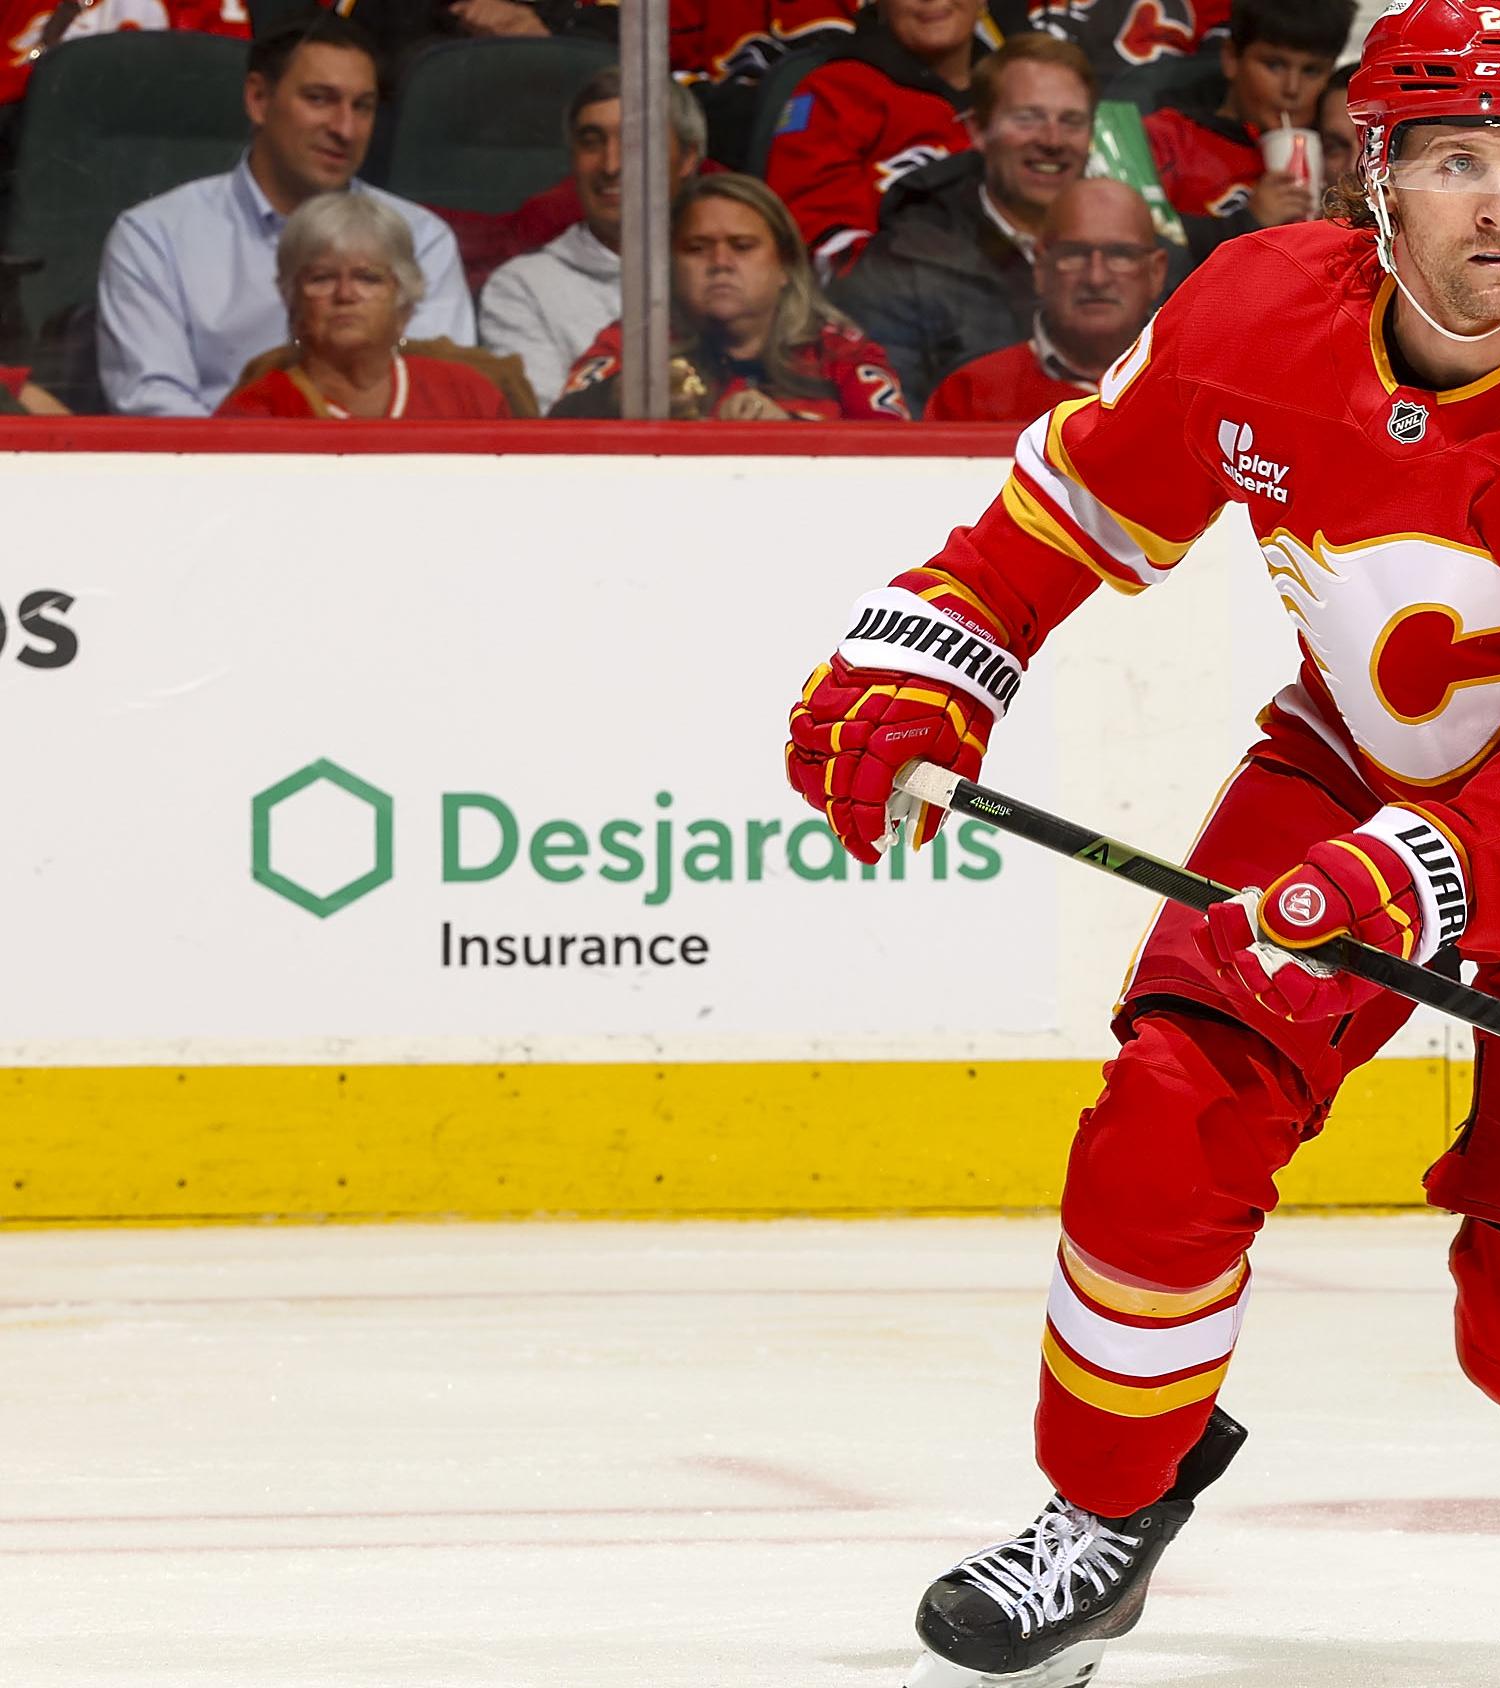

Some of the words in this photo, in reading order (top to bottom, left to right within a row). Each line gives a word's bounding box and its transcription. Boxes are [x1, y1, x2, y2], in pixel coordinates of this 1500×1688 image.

[1395, 414, 1421, 432] NHL
[1222, 461, 1288, 503] alberta
[1238, 453, 1290, 485] play
[441, 921, 711, 969] Insurance
